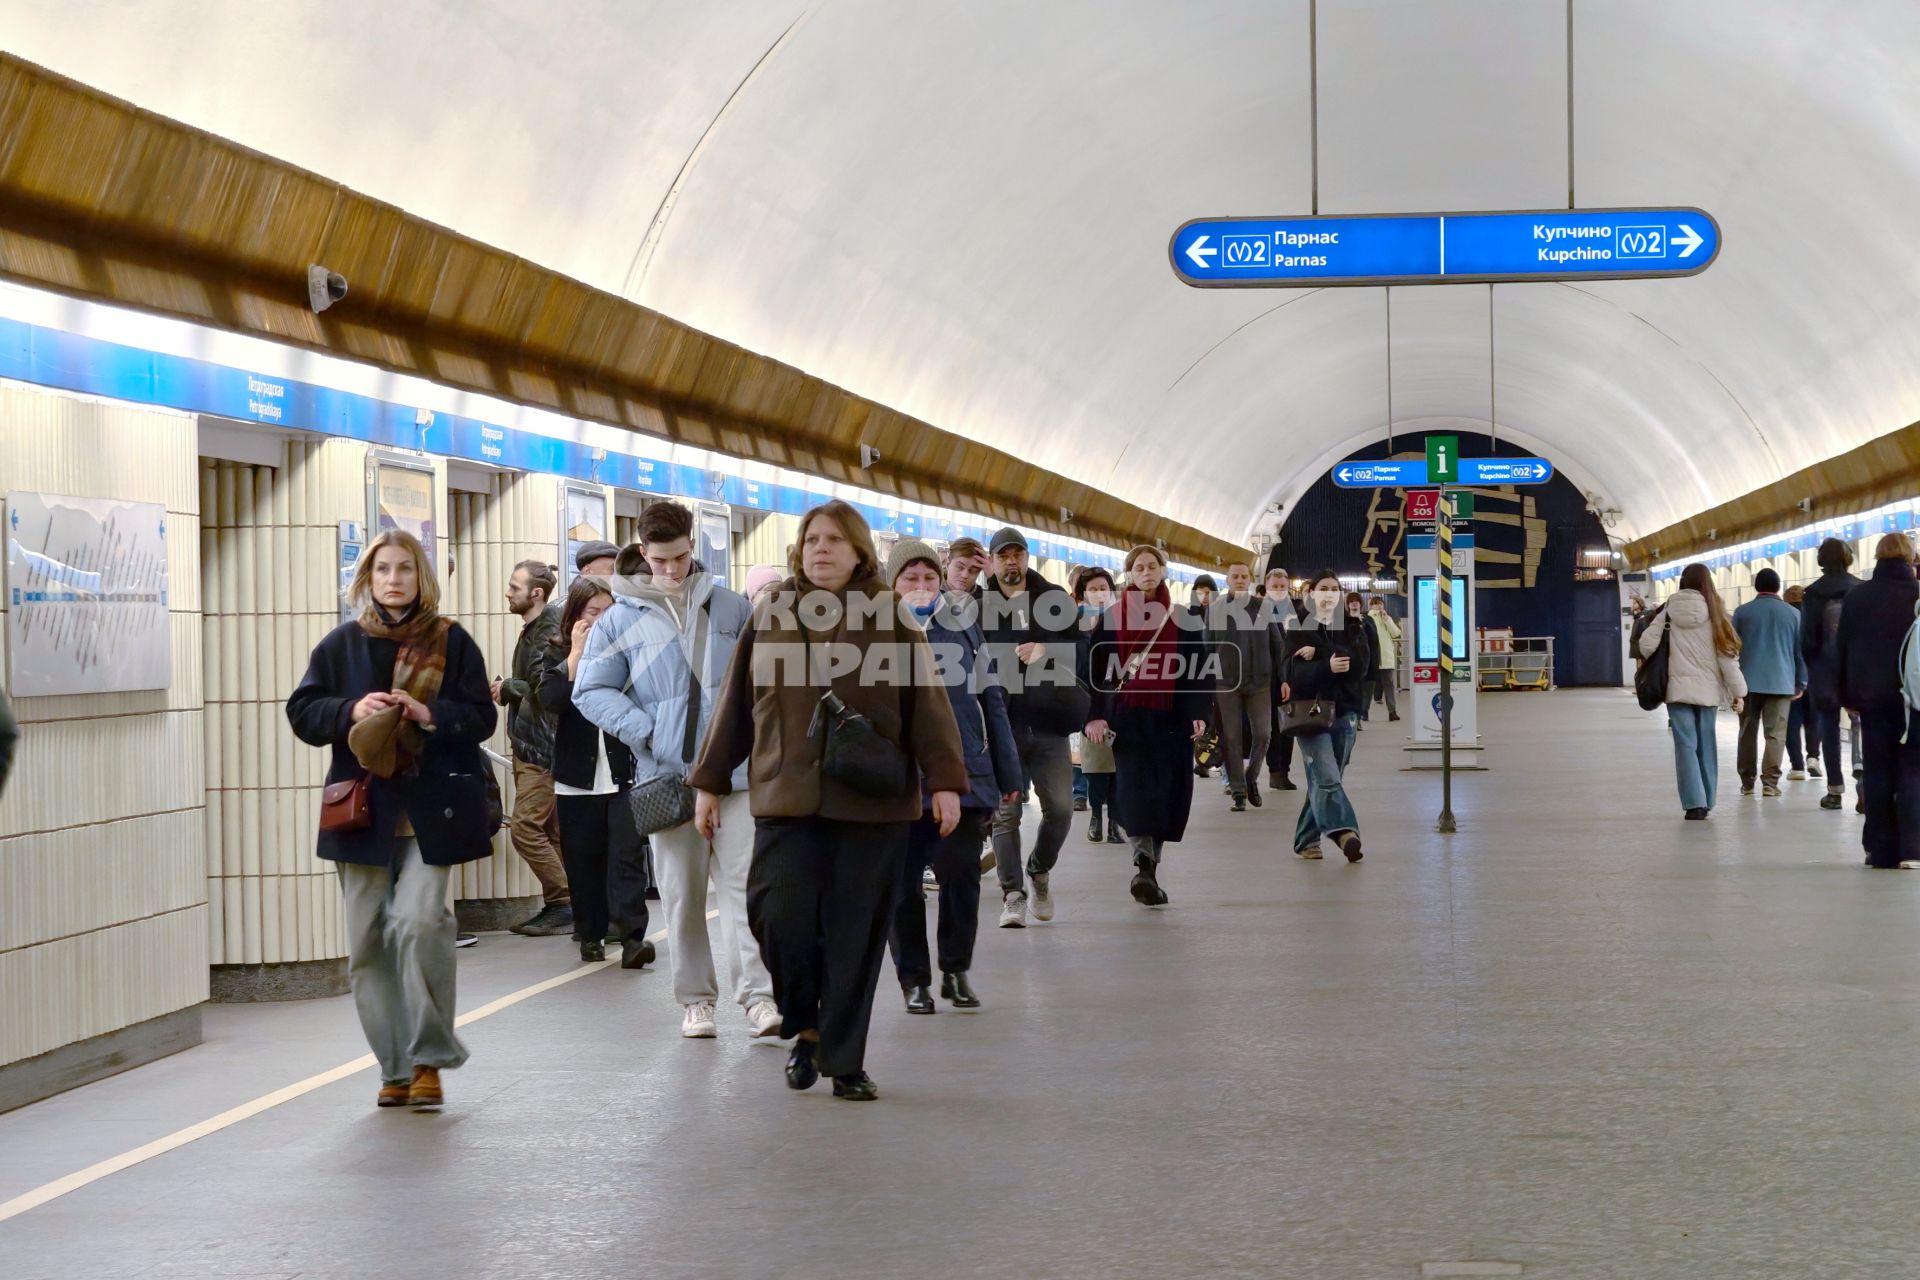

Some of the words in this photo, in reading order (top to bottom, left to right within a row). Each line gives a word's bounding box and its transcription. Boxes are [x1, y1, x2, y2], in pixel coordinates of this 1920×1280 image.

[1275, 231, 1339, 248] Парнас
[1533, 225, 1611, 242] Купчино
[1275, 254, 1327, 267] Parnas
[1538, 247, 1611, 264] Kupchino
[1374, 465, 1401, 473] Парнас
[1478, 464, 1510, 472] Купчино
[1480, 472, 1510, 480] Kupchino
